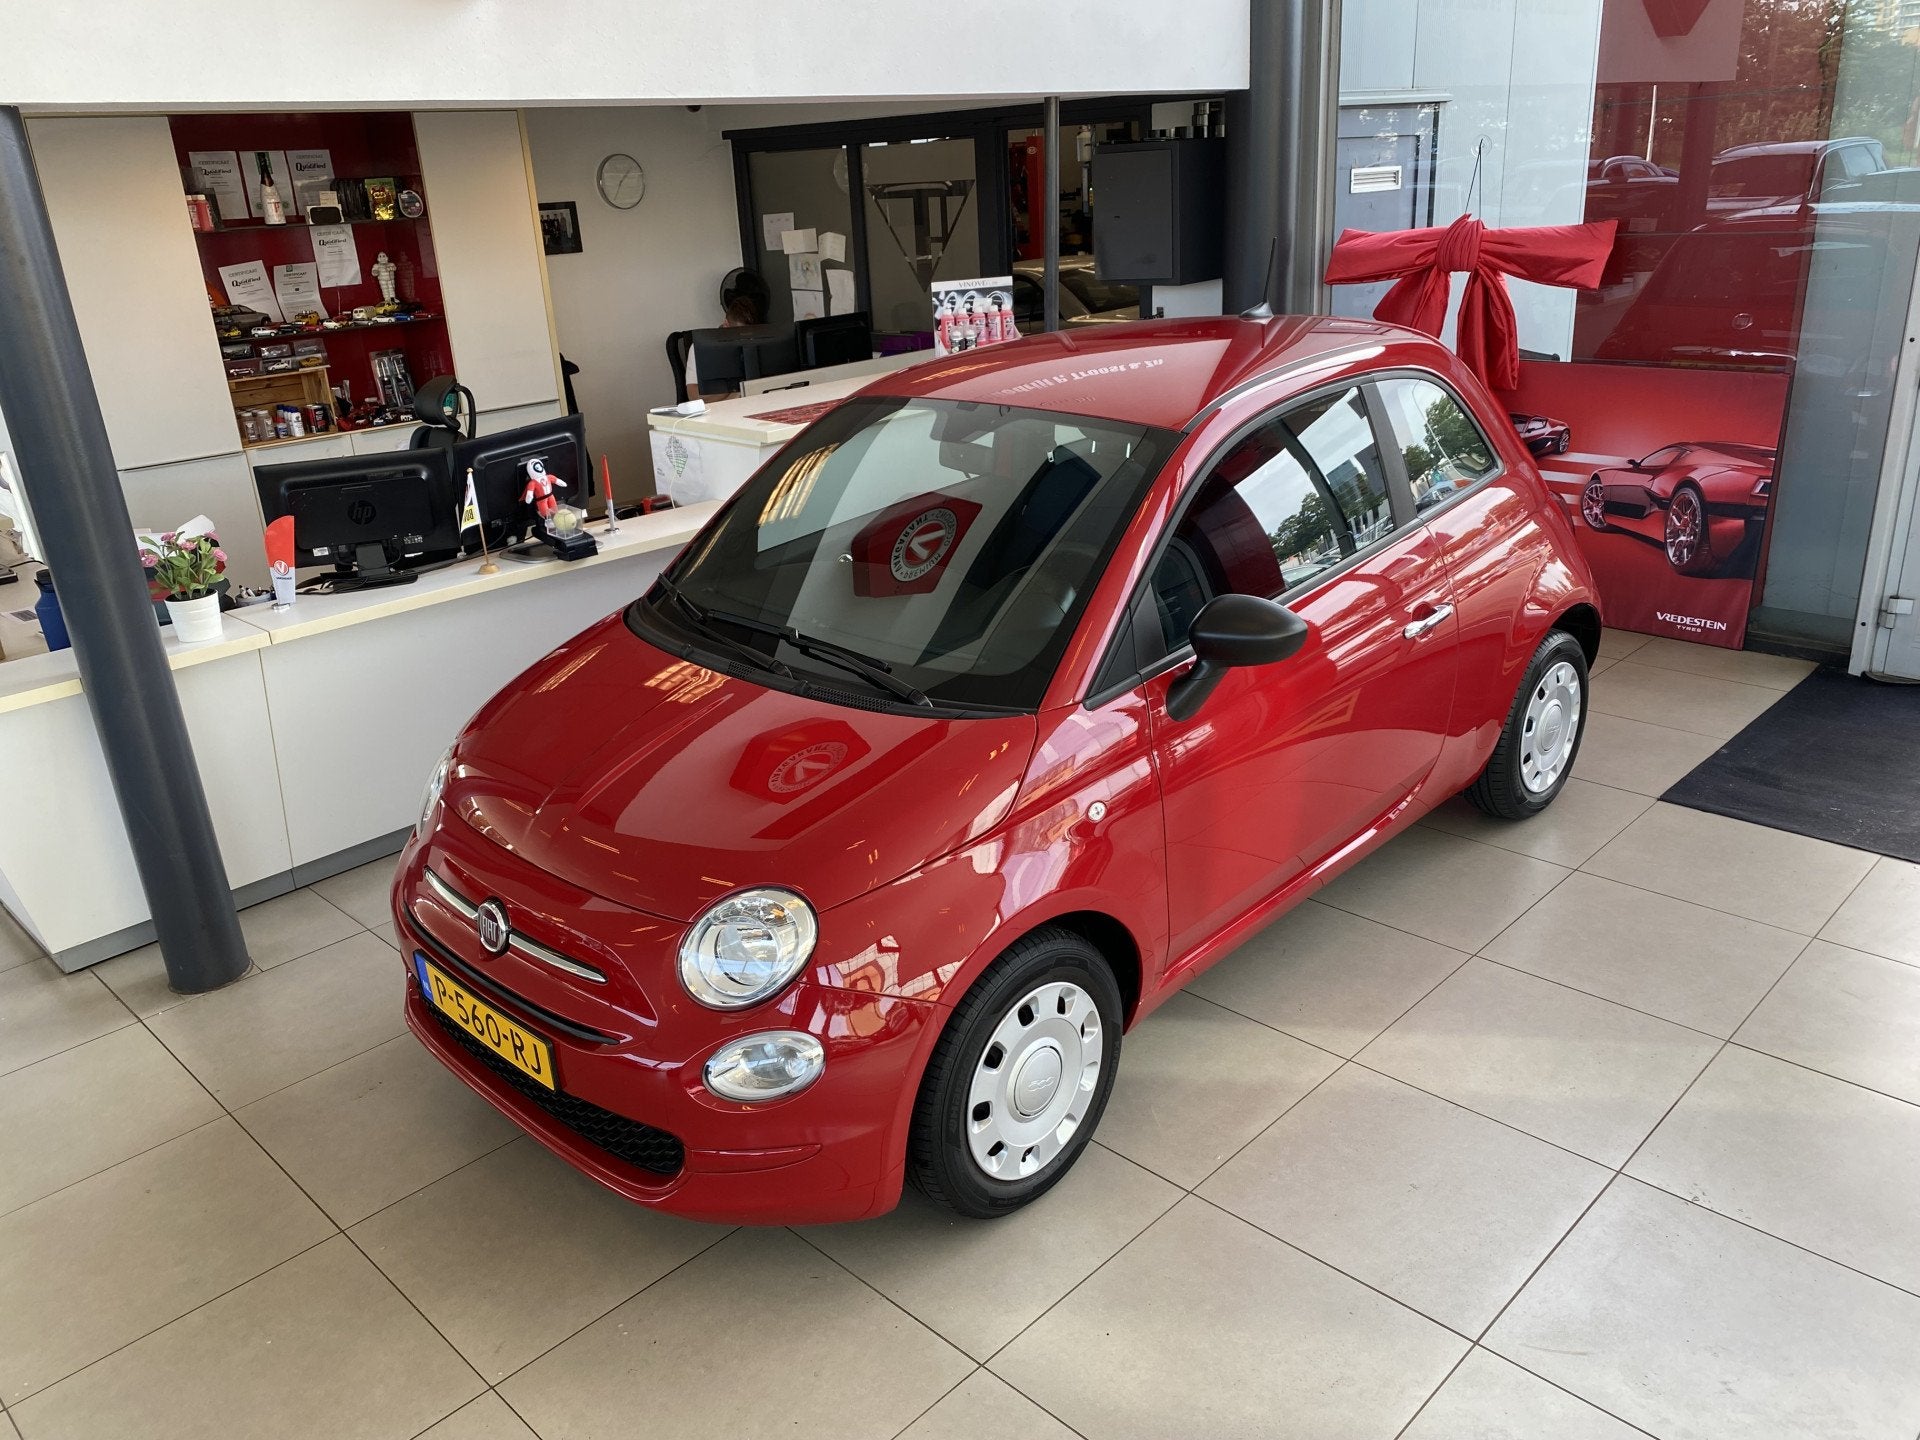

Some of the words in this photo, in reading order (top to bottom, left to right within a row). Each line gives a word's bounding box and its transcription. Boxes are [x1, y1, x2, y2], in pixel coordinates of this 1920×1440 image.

[353, 501, 374, 525] hp
[1656, 611, 1727, 631] VREDESTEIN
[1676, 624, 1702, 633] TYRES
[482, 915, 498, 942] FIAT
[434, 974, 542, 1075] P-560-RJ
